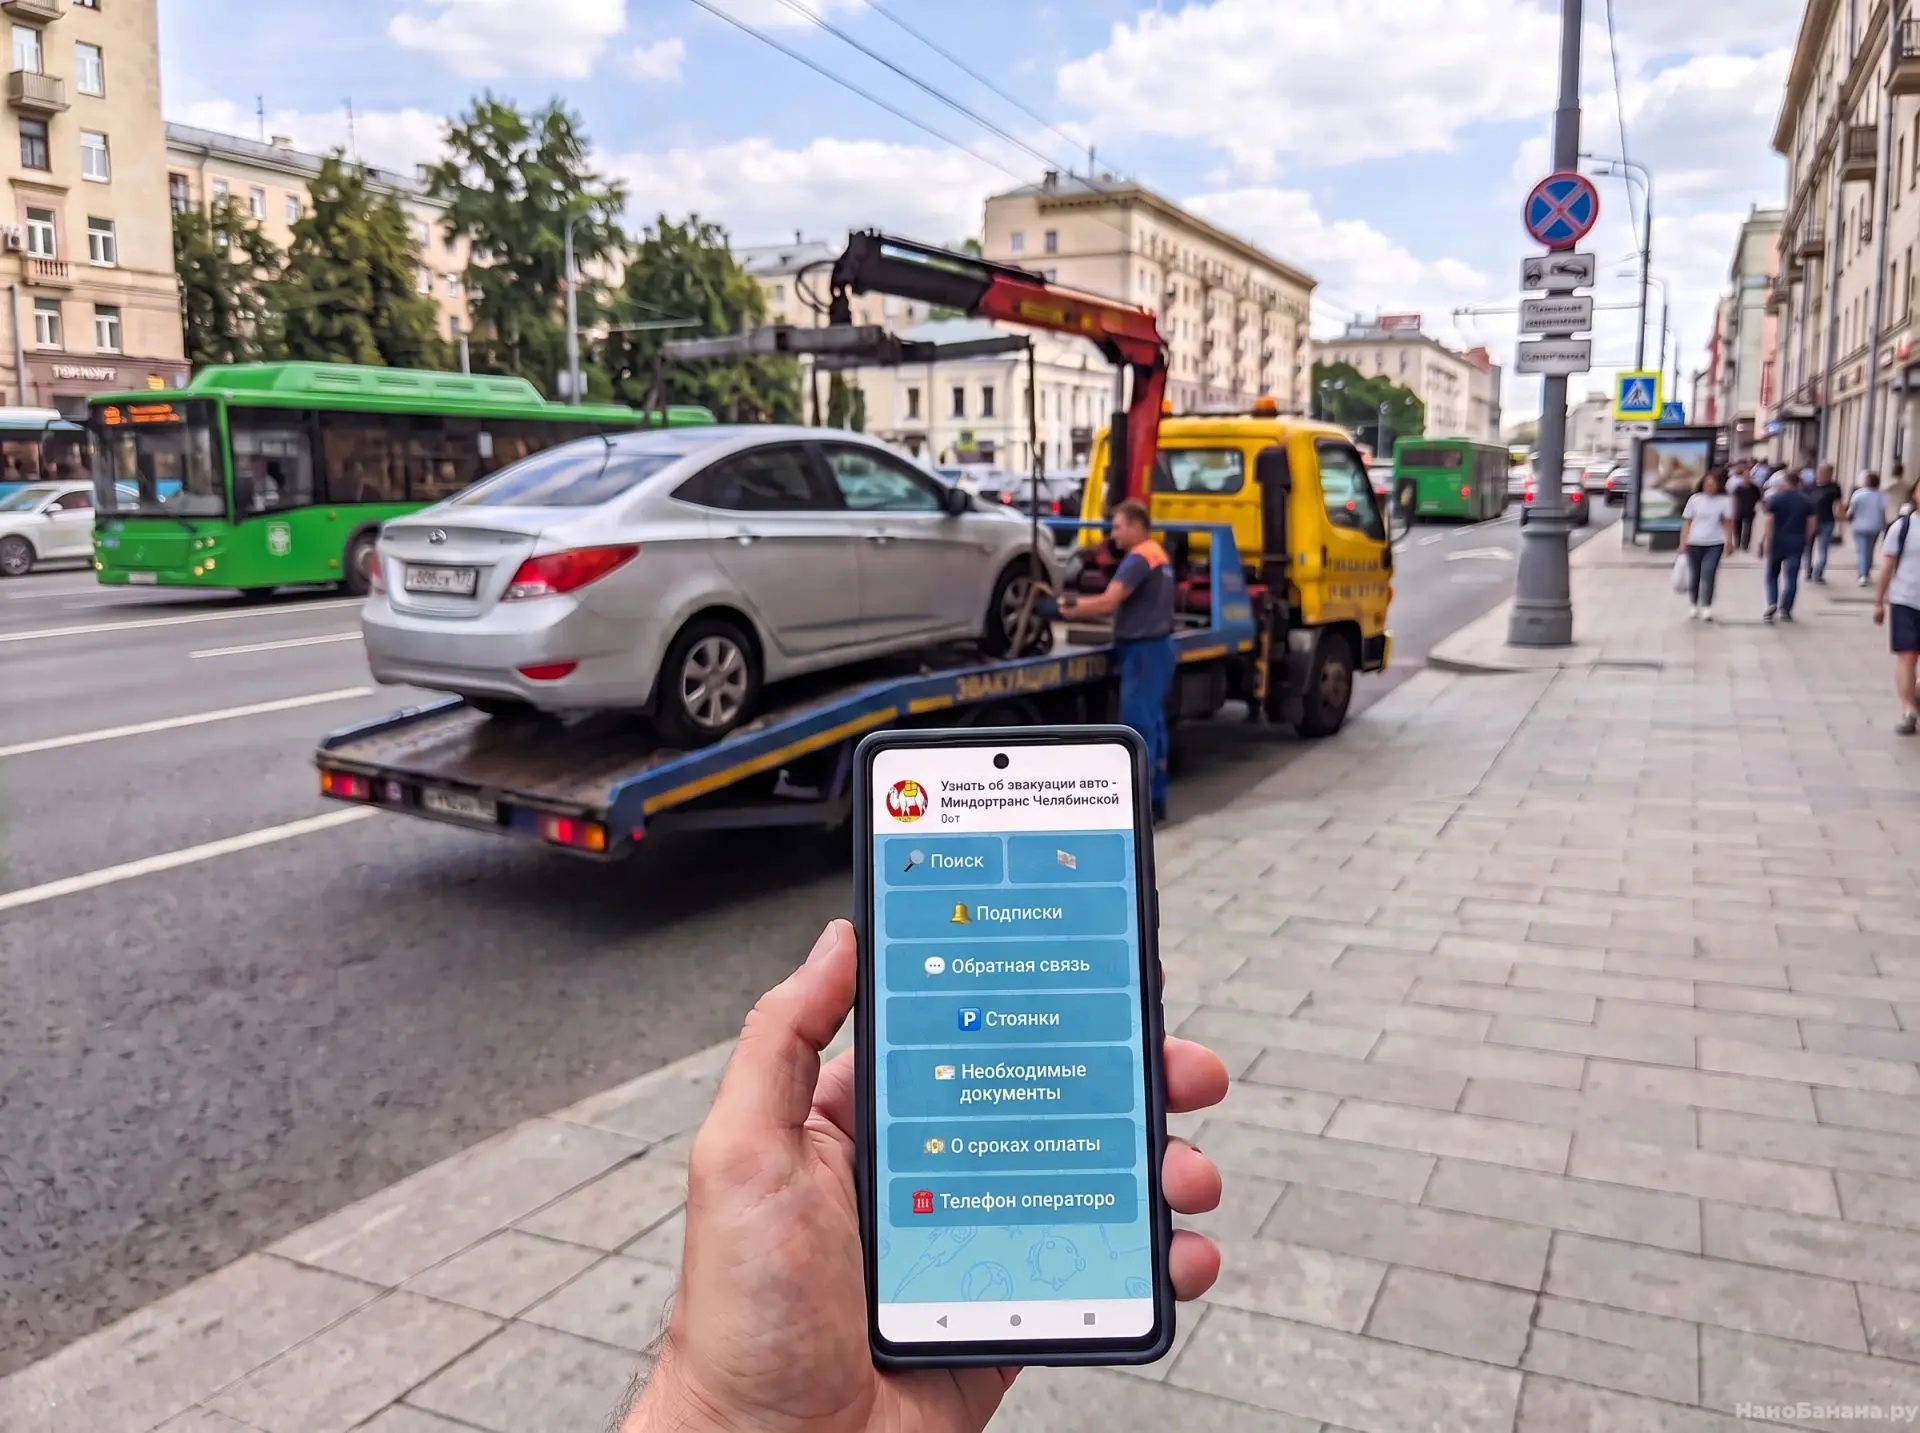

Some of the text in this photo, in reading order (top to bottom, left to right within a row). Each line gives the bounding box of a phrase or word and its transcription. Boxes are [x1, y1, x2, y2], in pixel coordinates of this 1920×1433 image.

[940, 780, 985, 792] Узнать
[988, 779, 1004, 791] об
[1007, 779, 1076, 793] эвакуации
[1079, 779, 1109, 789] авто
[941, 793, 1119, 810] Миндортранс Челябинской
[931, 853, 984, 868] Поиск
[977, 904, 1063, 922] Подписки
[951, 957, 1090, 977] Обратная связь
[986, 1010, 1060, 1027] Стоянки
[961, 1062, 1087, 1081] Необходимые
[959, 1087, 1061, 1105] документы
[951, 1137, 1101, 1157] О сроках оплаты
[939, 1191, 1116, 1212] Телефон операторо
